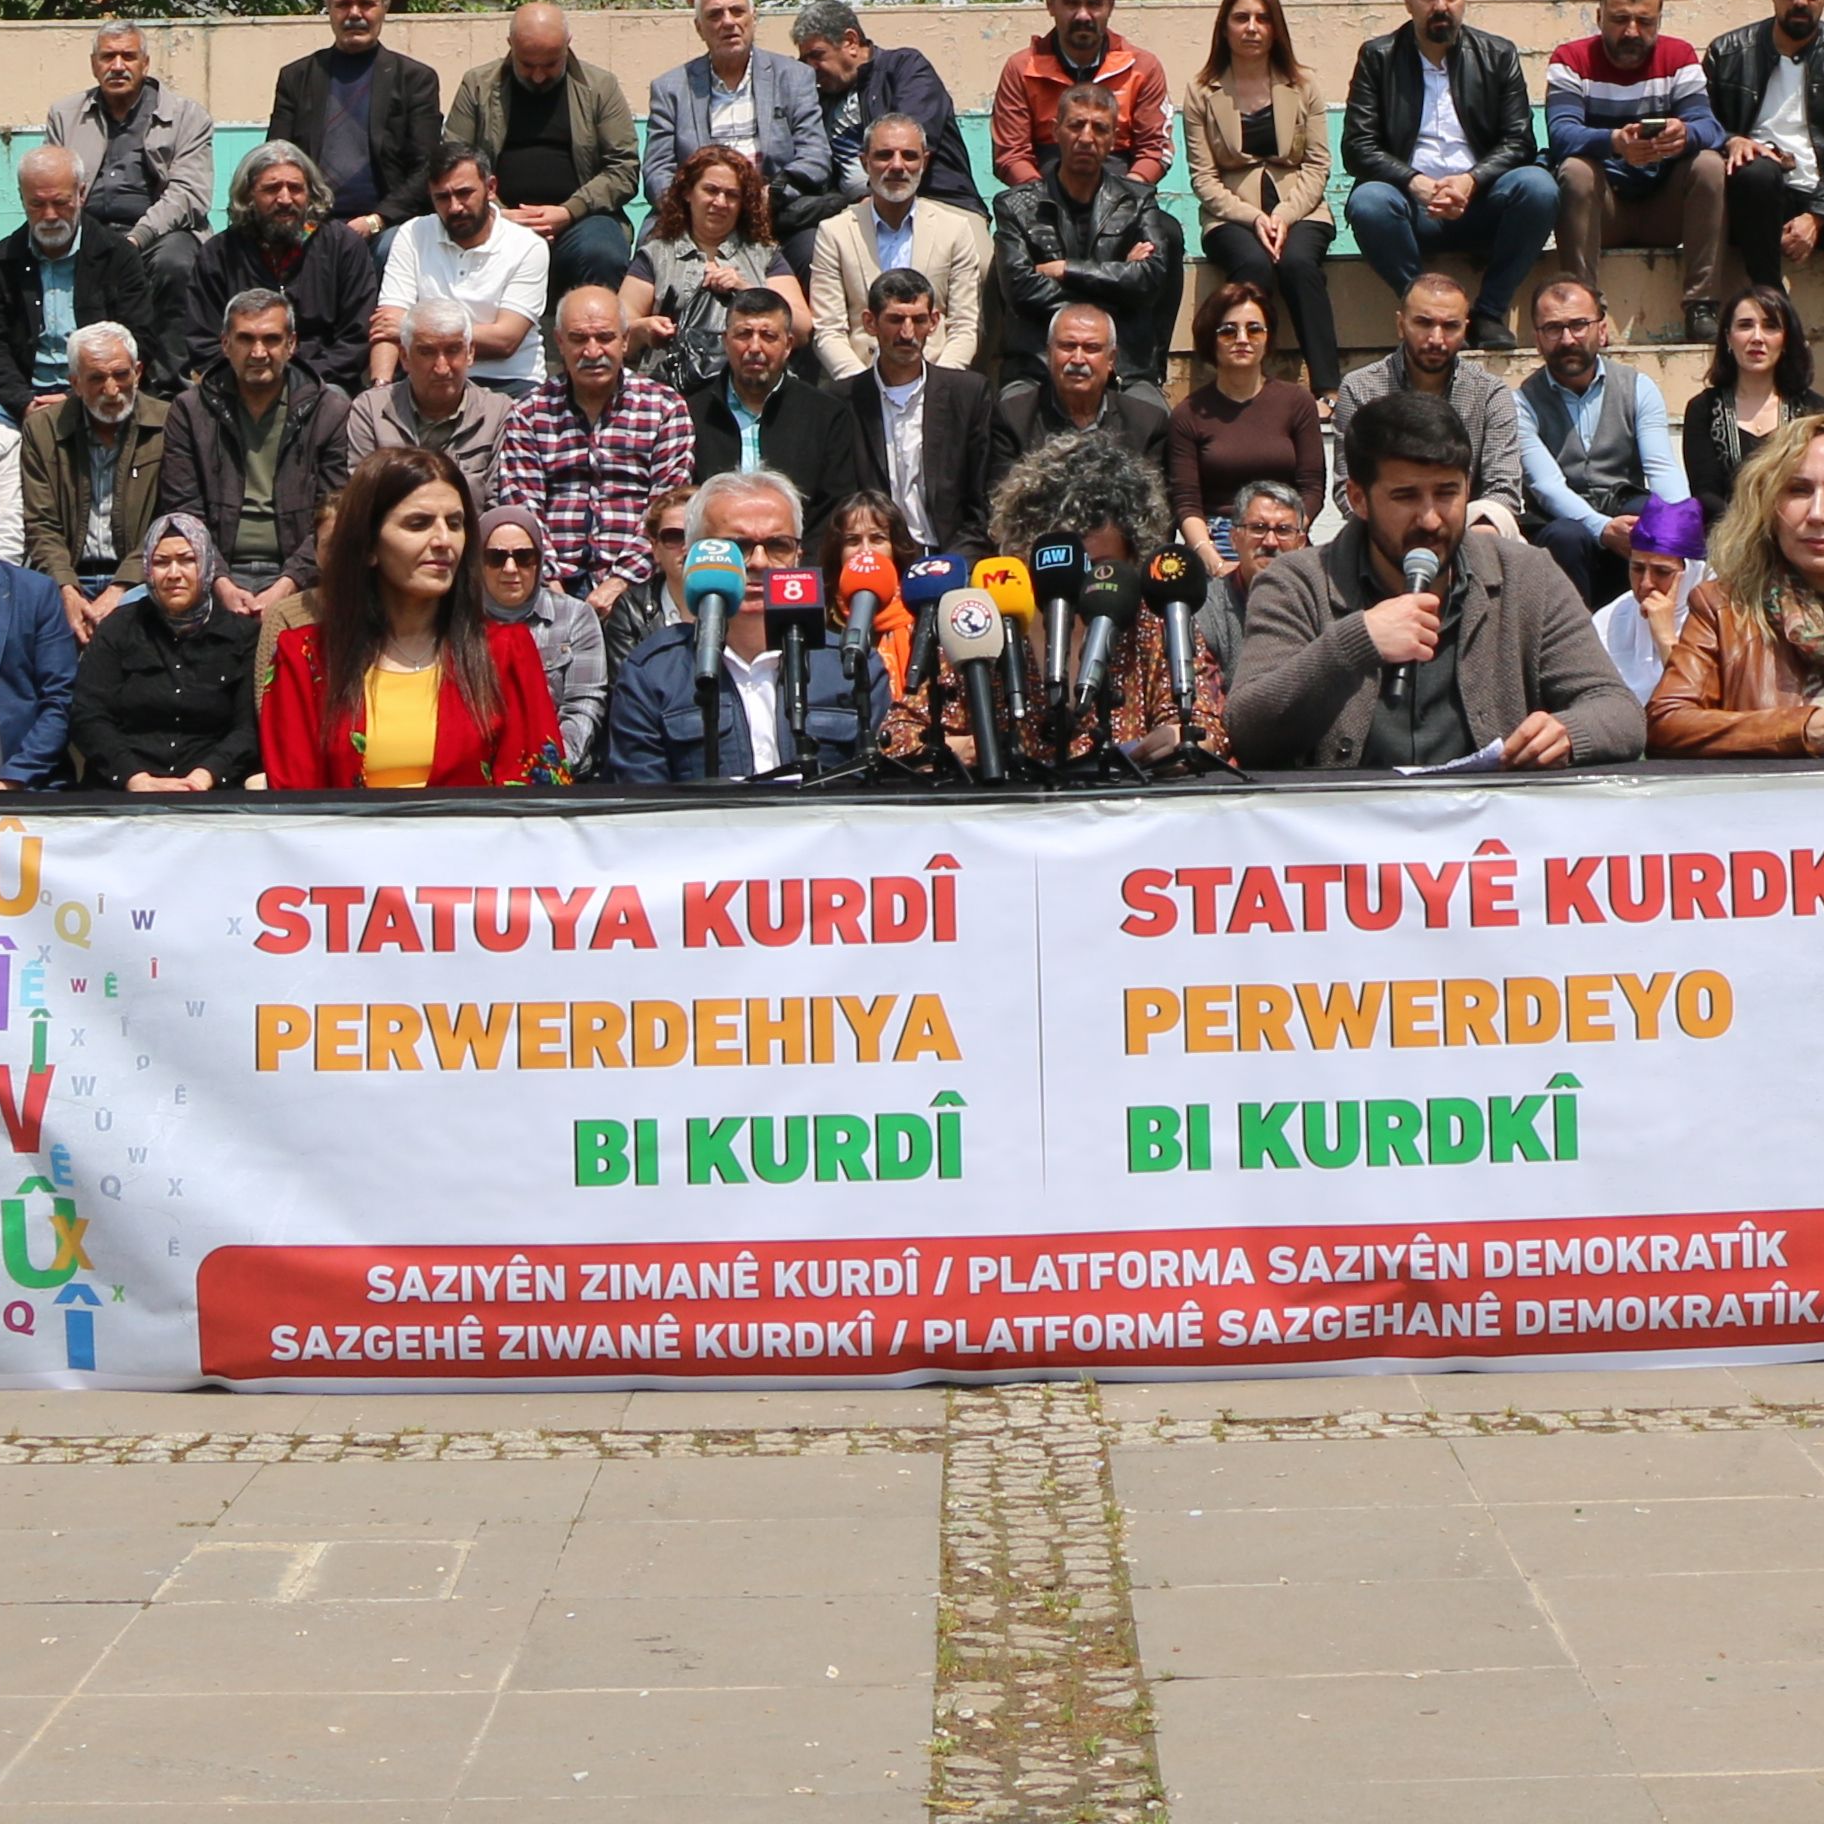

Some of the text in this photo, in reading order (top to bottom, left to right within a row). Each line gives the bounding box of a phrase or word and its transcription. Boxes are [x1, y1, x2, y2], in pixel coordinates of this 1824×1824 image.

[695, 554, 733, 564] SPEDA
[772, 573, 813, 581] CHANNEL
[1041, 548, 1067, 564] AW
[783, 580, 804, 600] 8
[254, 853, 962, 955] STATUYA KURDÎ
[1120, 839, 1520, 937] STATUYÊ
[54, 901, 91, 950] Q
[131, 910, 156, 930] W
[71, 978, 87, 993] W
[255, 994, 963, 1072] PERWERDEHIYA
[1124, 970, 1733, 1055] PERWERDEYO
[574, 1091, 965, 1186] BI KURDÎ
[1127, 1073, 1582, 1172] BI KURDKÎ
[48, 1215, 95, 1270] X
[366, 1220, 1788, 1303] SAZIYÊN ZIMANÊ KURDÎ / PLATFORMA SAZIYÊN DEMOKRATÎK
[3, 1300, 35, 1336] Q
[112, 1285, 125, 1302] X
[270, 1314, 484, 1363] SAZGEHÊ
[498, 1312, 681, 1361] ZIWANÊ
[695, 1309, 876, 1358] KURDKÎ
[889, 1320, 908, 1356] /
[923, 1299, 1204, 1354] PLATFORMÊ
[1217, 1291, 1502, 1347] SAZGEHANÊ
